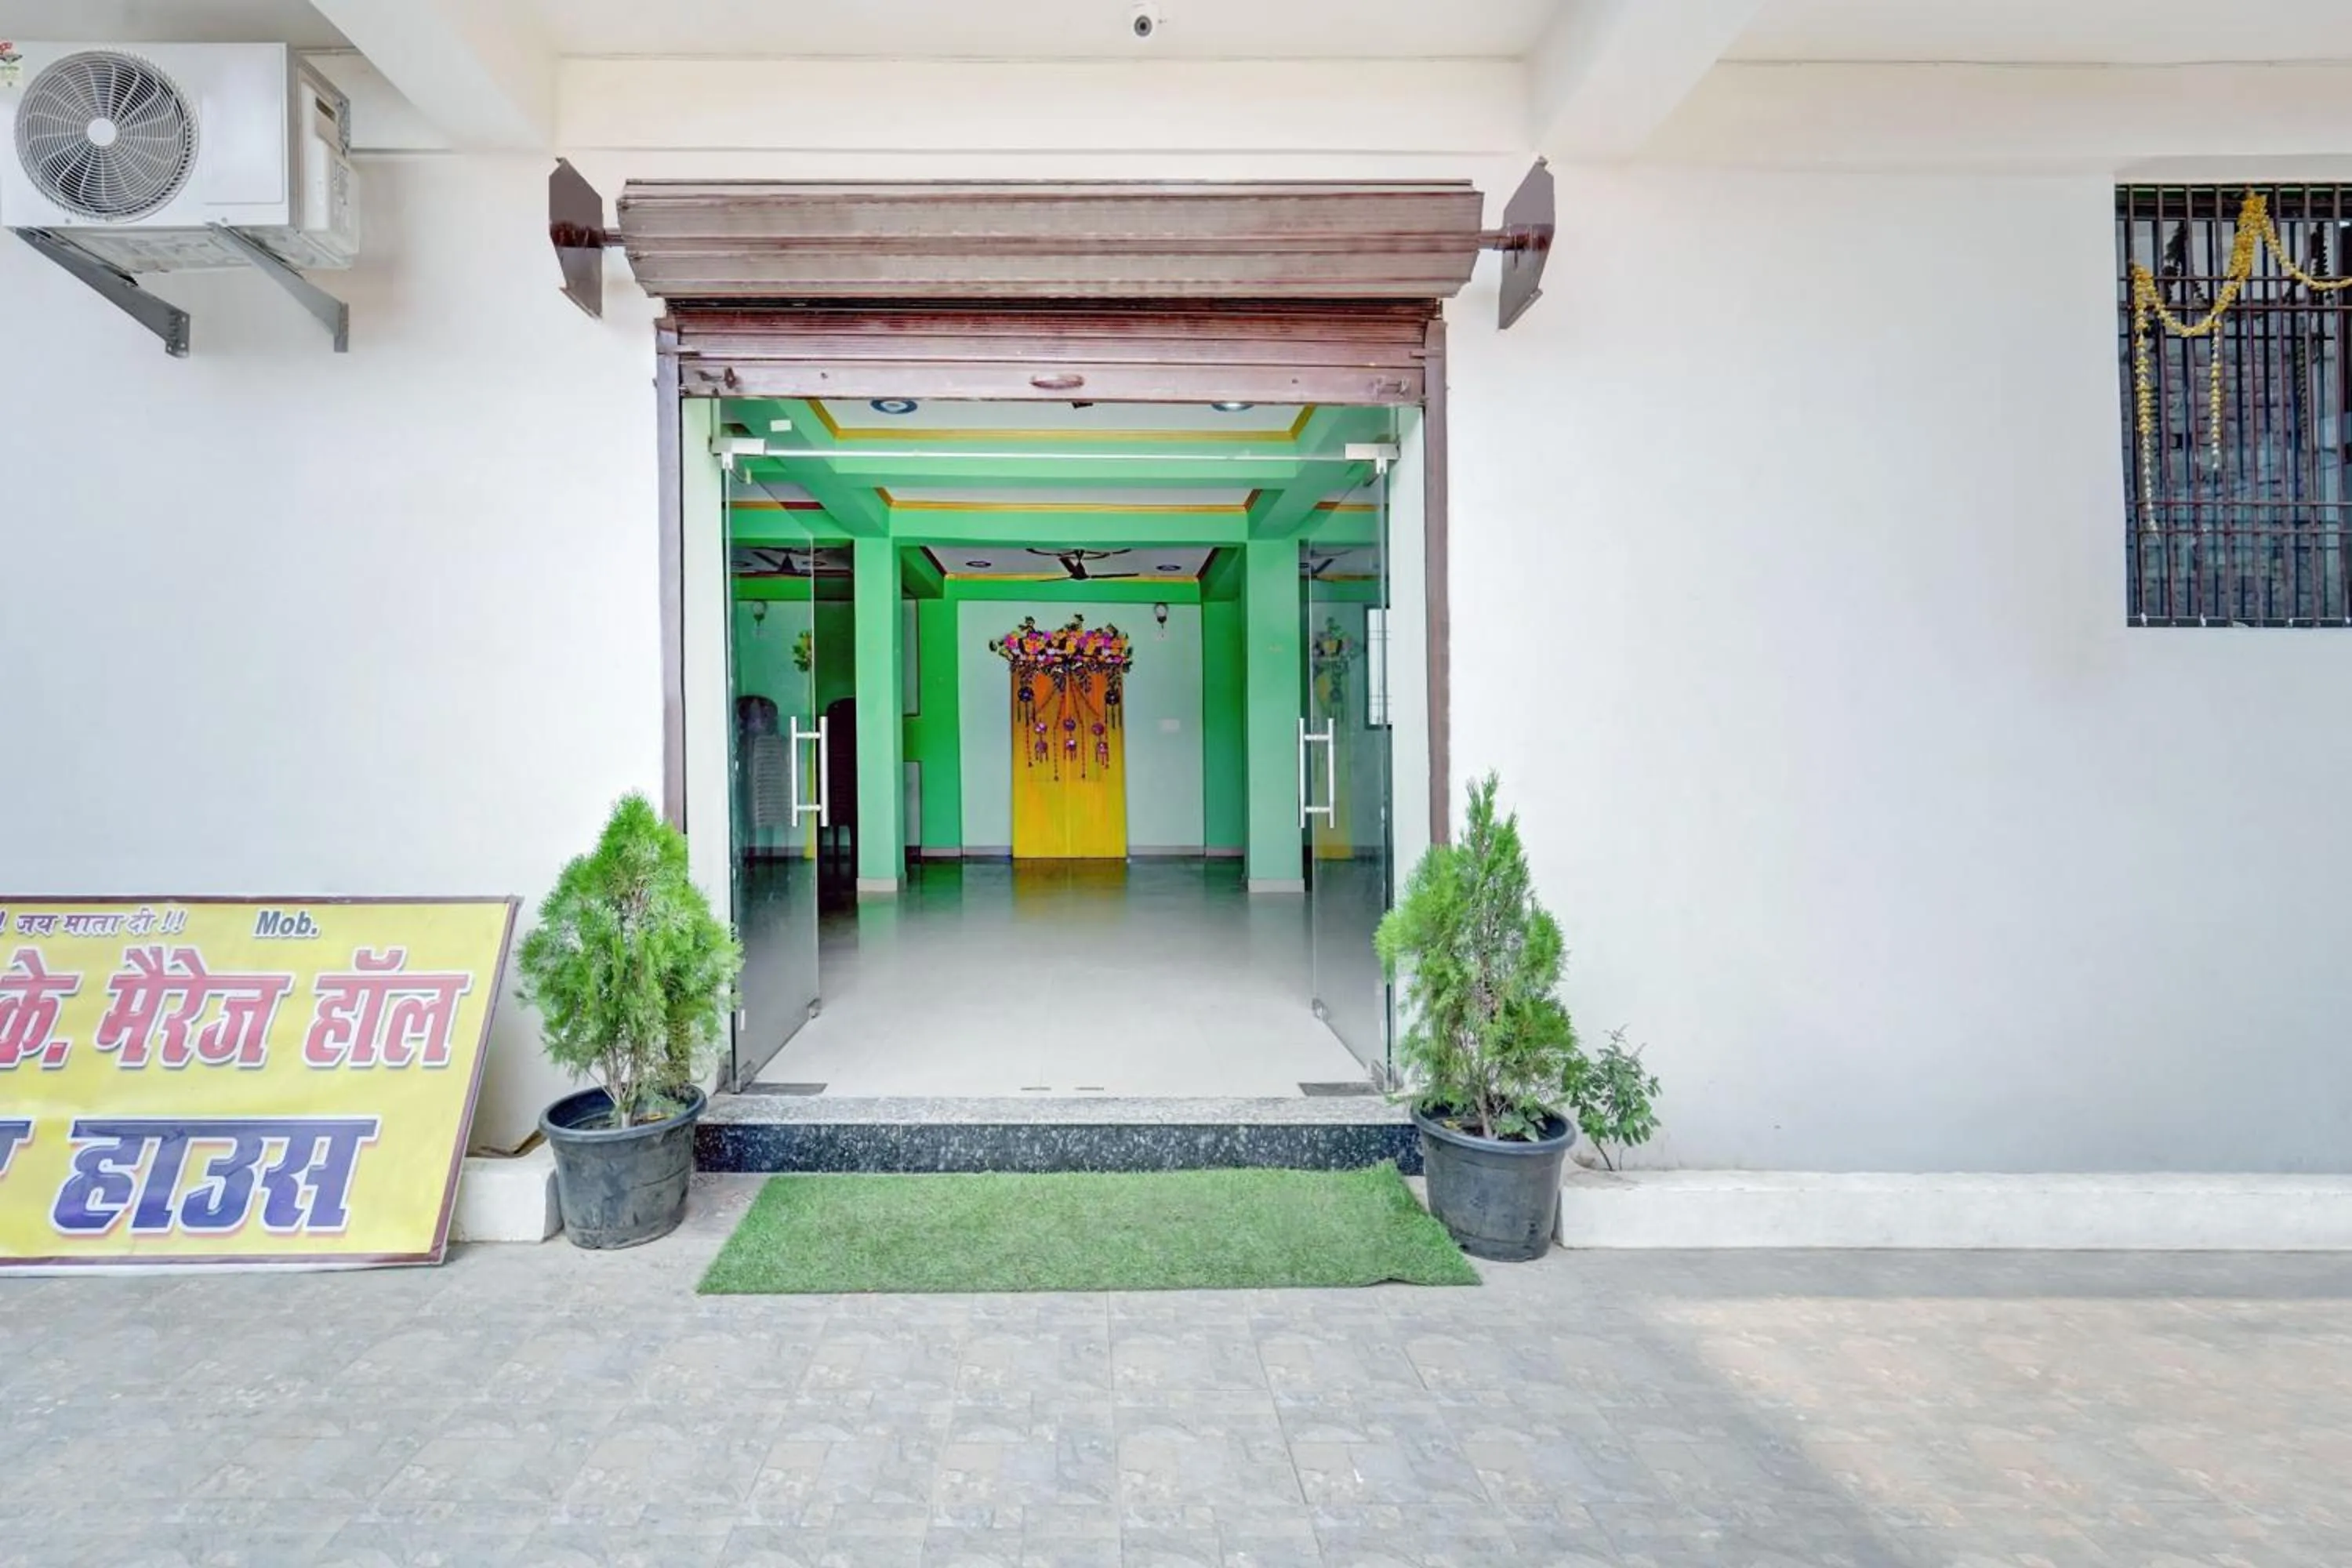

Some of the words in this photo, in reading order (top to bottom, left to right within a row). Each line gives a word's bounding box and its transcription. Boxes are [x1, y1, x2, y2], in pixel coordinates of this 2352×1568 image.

[17, 914, 58, 933] जय
[64, 914, 124, 933] माता
[127, 907, 156, 933] दी
[255, 909, 318, 935] Mob.
[96, 946, 292, 1064] मैरेज
[304, 949, 470, 1064] हॉल
[52, 1118, 379, 1229] हाउस
